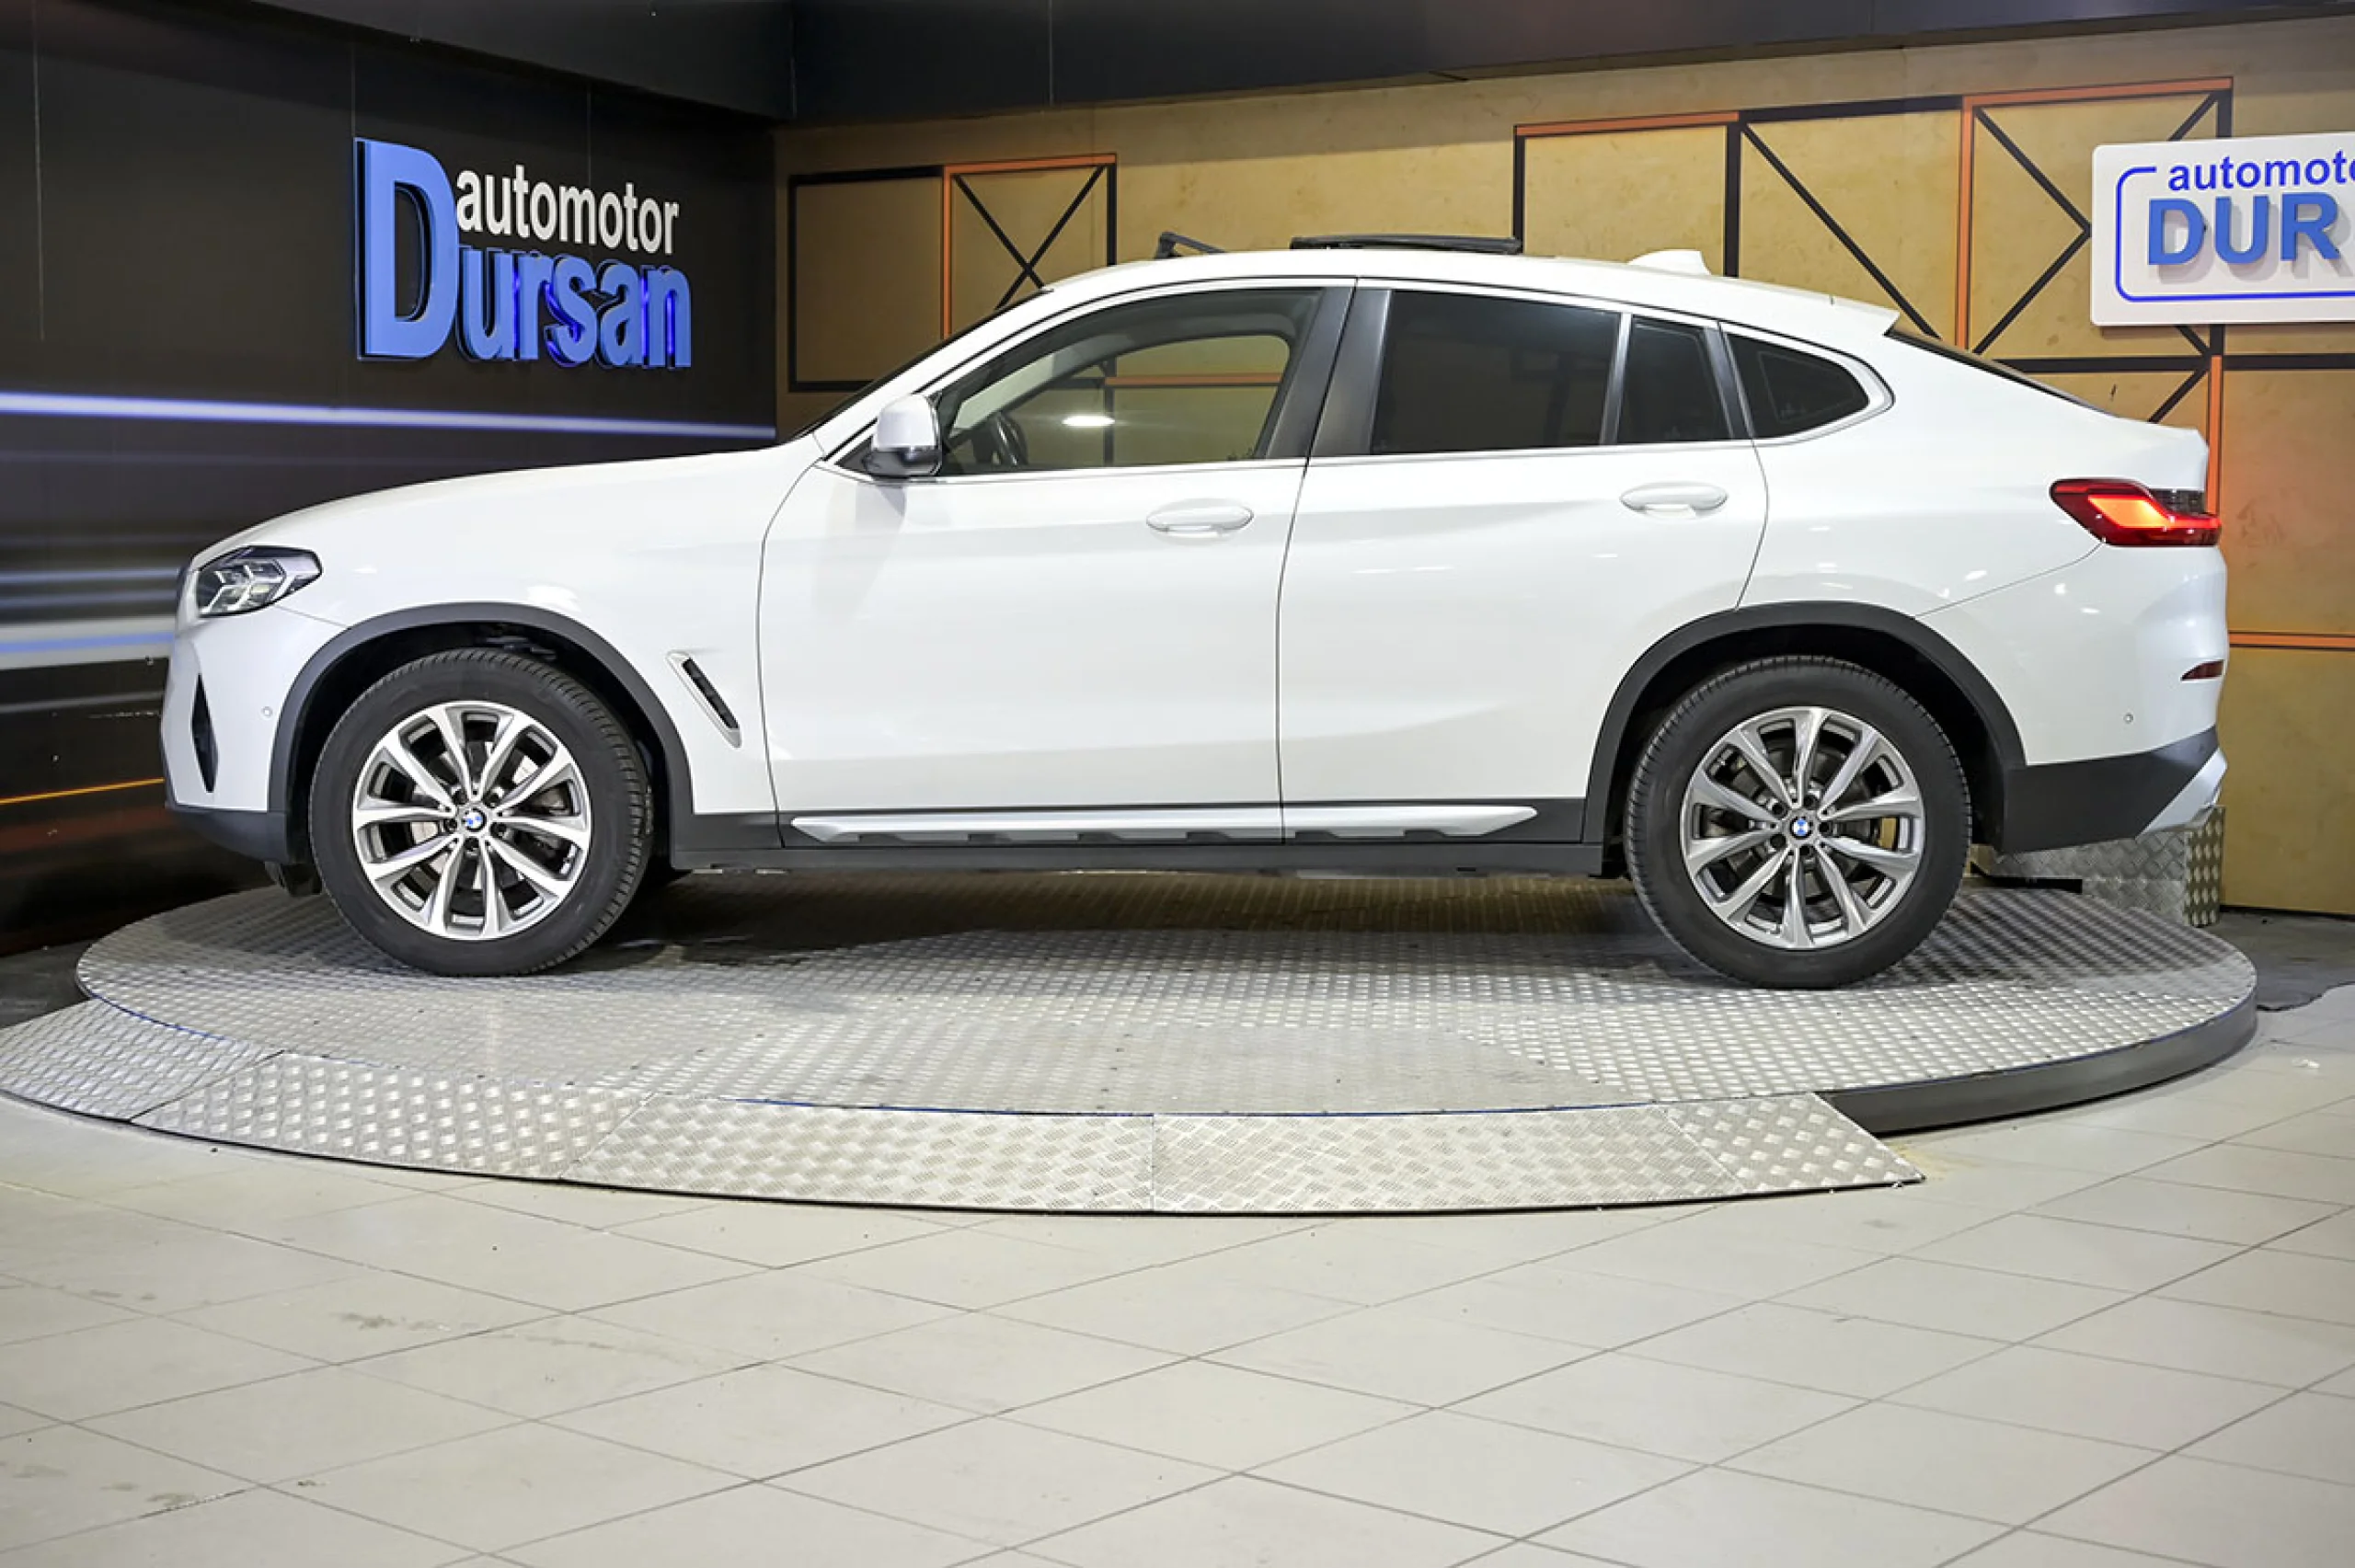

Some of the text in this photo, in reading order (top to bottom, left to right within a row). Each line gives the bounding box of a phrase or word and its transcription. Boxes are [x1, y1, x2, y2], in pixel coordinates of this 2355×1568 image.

[456, 165, 679, 254] automotor
[2168, 151, 2355, 190] automot
[354, 137, 692, 368] Dursan
[2148, 192, 2340, 265] DUR
